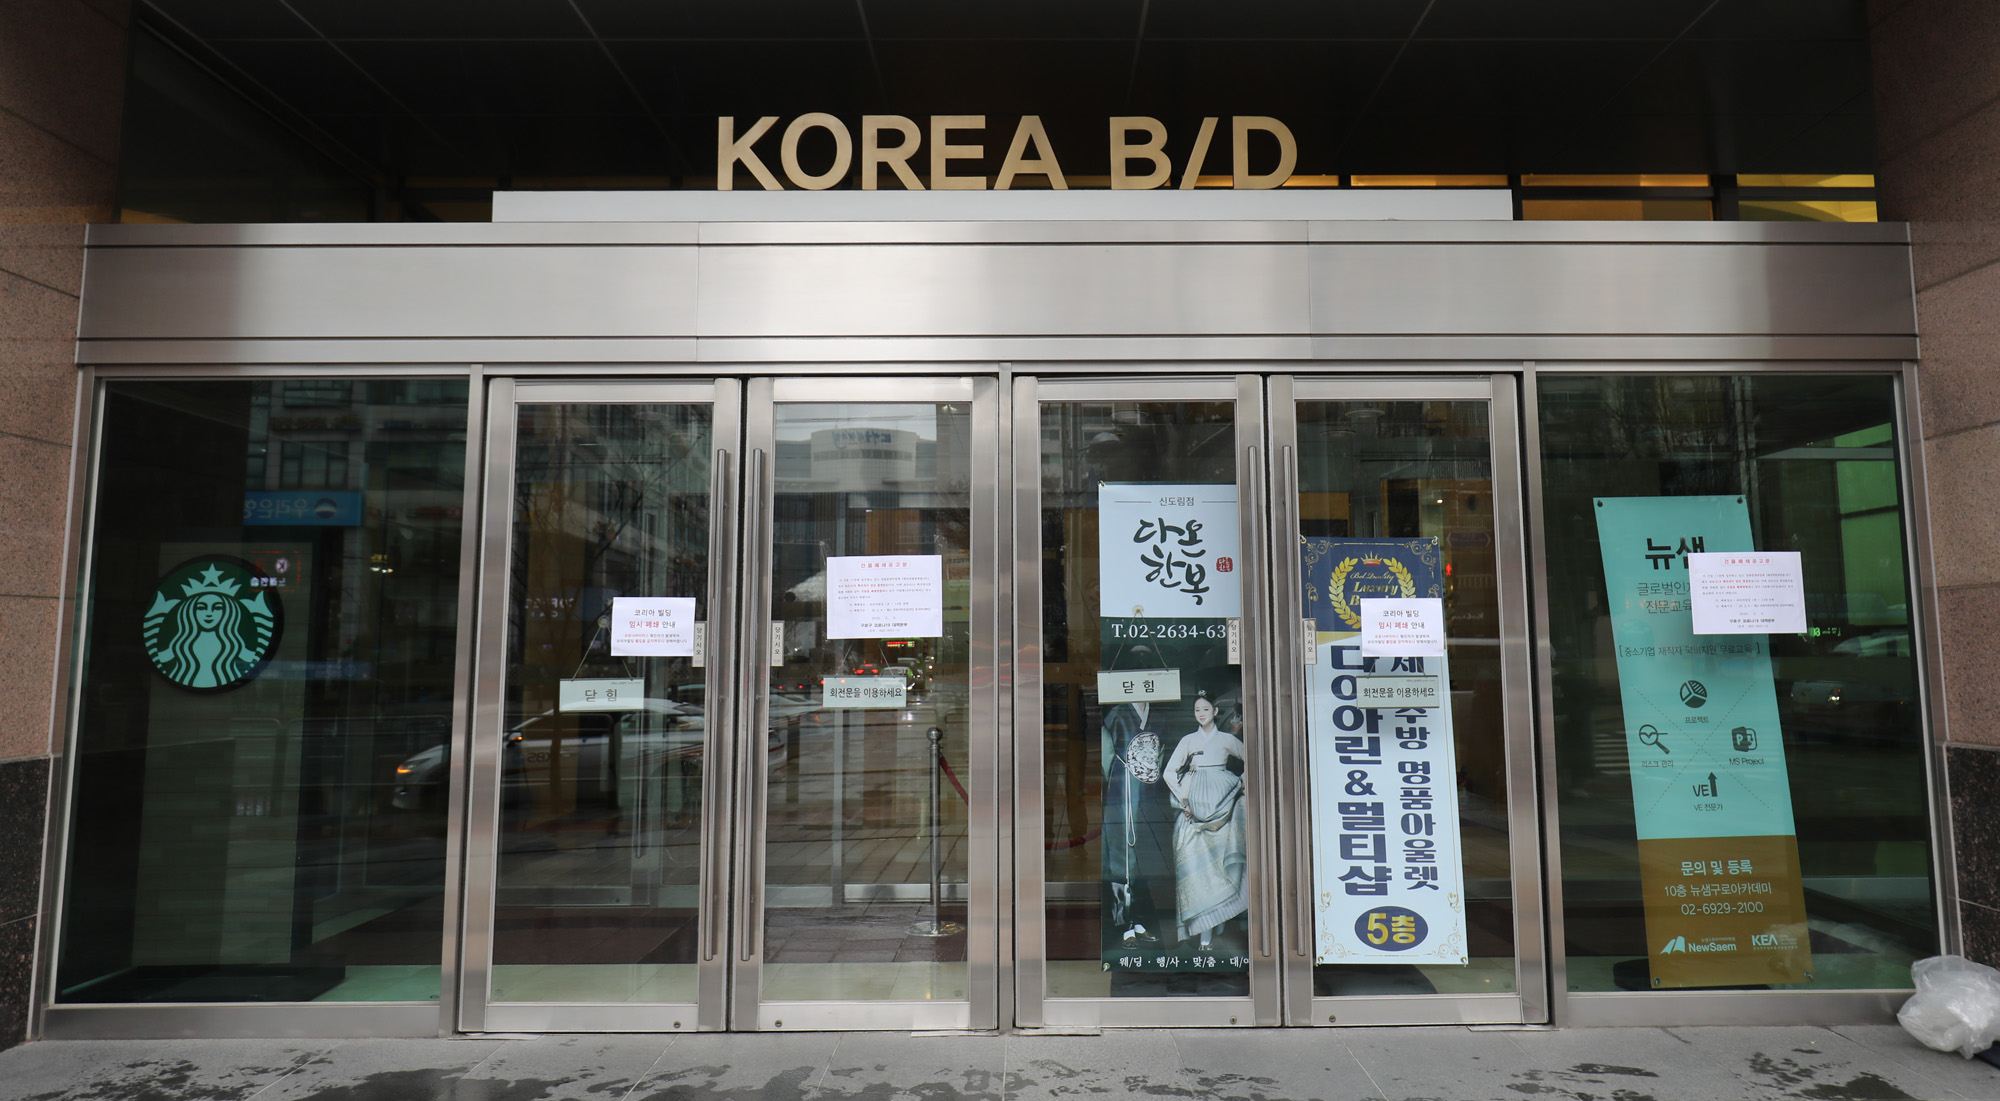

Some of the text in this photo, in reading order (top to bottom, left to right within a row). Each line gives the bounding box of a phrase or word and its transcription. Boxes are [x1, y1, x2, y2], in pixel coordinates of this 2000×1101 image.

[717, 112, 1298, 190] KOREA B/D
[1159, 496, 1194, 507] 신도림점
[1133, 517, 1206, 558] 다온
[1140, 544, 1210, 606] 한복
[1353, 582, 1398, 595] Luxury
[634, 609, 672, 617] 코리아 빌딩
[830, 687, 902, 698] 회전문을 이용하세요
[1363, 687, 1435, 698] 회전문을 이용하세요
[1729, 758, 1765, 766] MS Project
[1397, 761, 1439, 890] 명품아울렛
[1681, 859, 1753, 876] 문의 및 등록
[1664, 882, 1772, 898] 10층 뉴샘구로아카데미
[1681, 901, 1764, 915] 02-6929-2100
[1367, 913, 1416, 945] 5층
[1688, 942, 1737, 952] NewSaem
